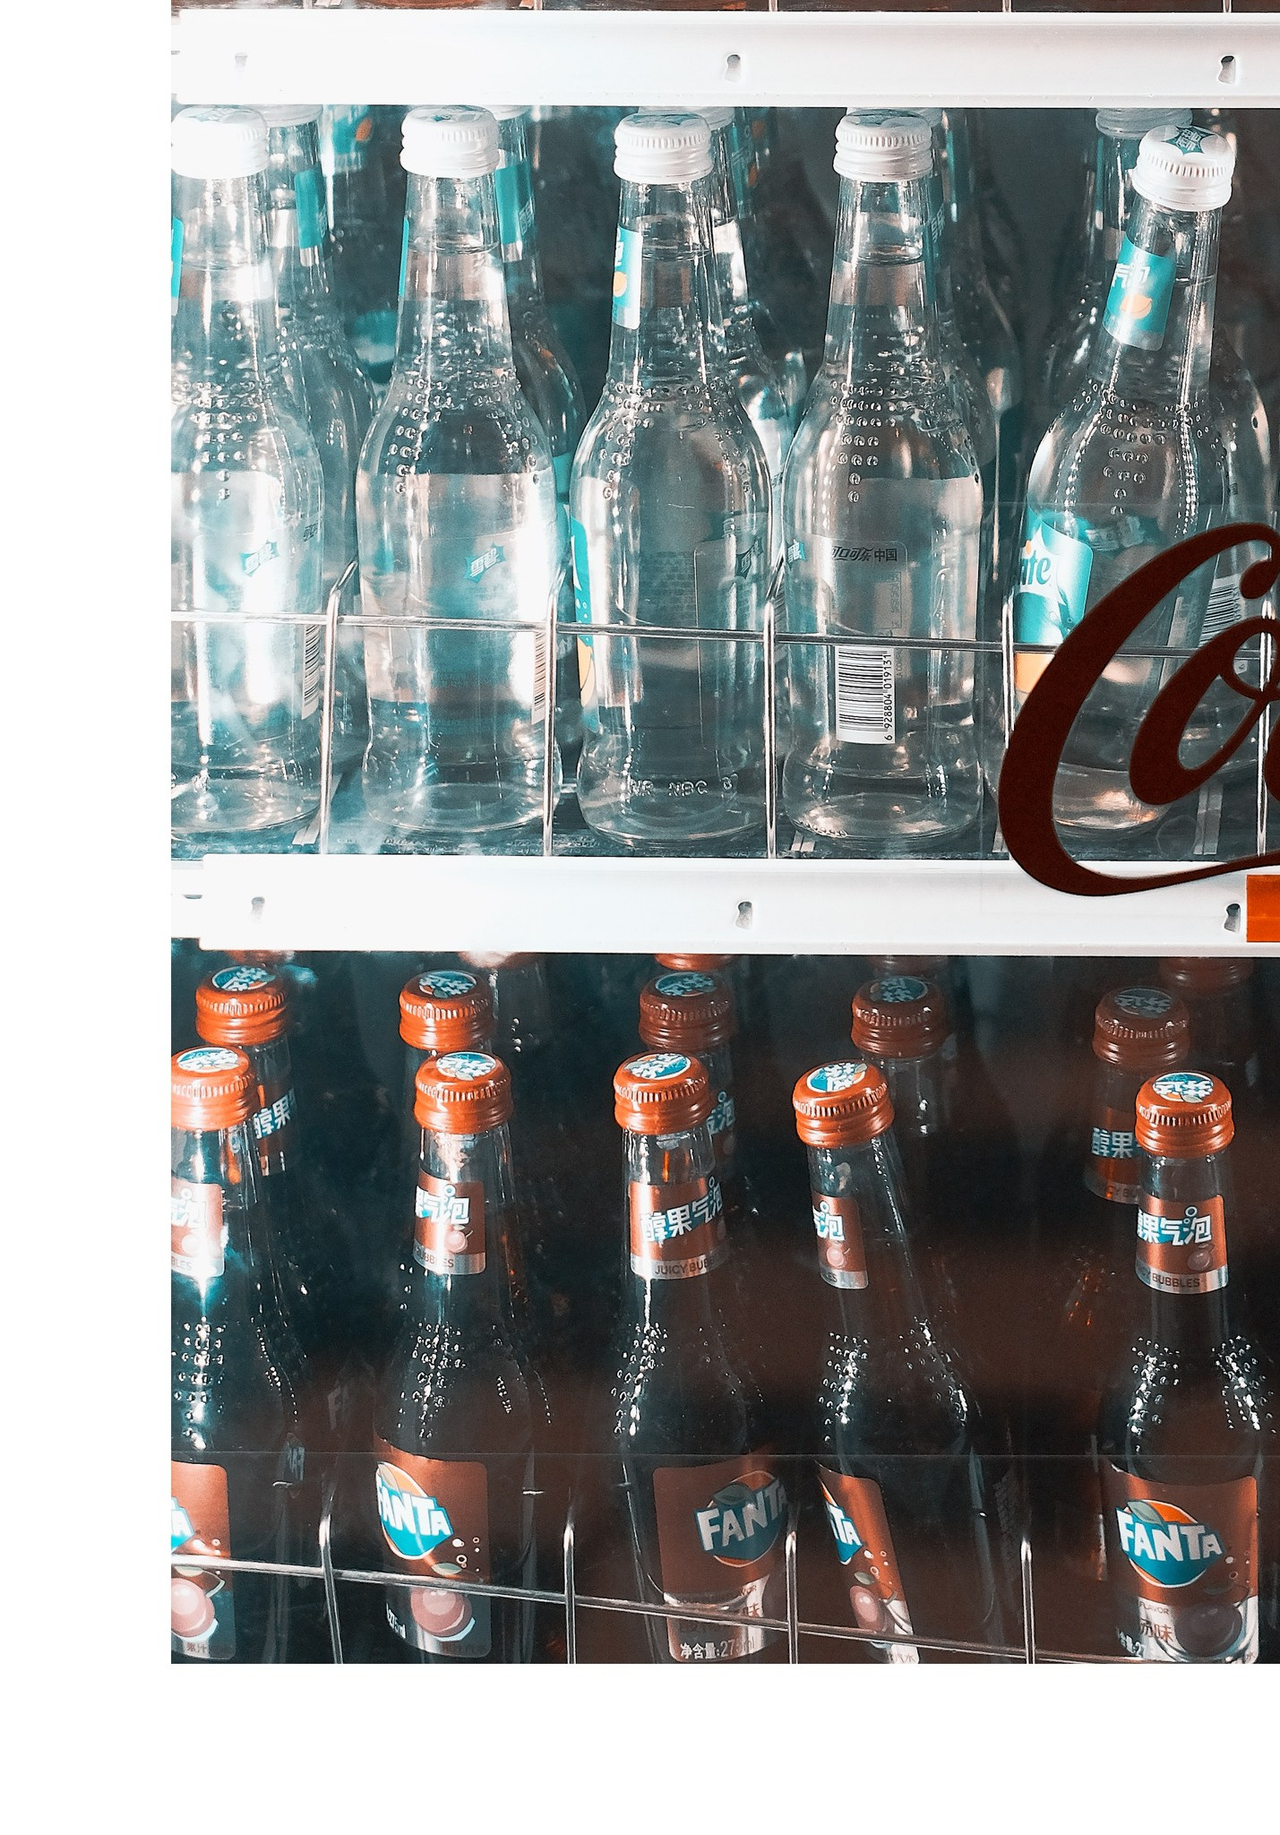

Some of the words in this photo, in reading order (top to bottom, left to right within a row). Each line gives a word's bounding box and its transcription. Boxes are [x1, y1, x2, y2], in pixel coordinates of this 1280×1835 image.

[883, 653, 893, 690] 019131
[883, 693, 893, 729] 928804
[1137, 1206, 1213, 1246] 果气泡
[655, 1260, 689, 1276] JUICY
[1152, 1272, 1201, 1288] BUBBLES
[696, 1482, 788, 1552] FANTA
[1115, 1509, 1224, 1562] FANTA
